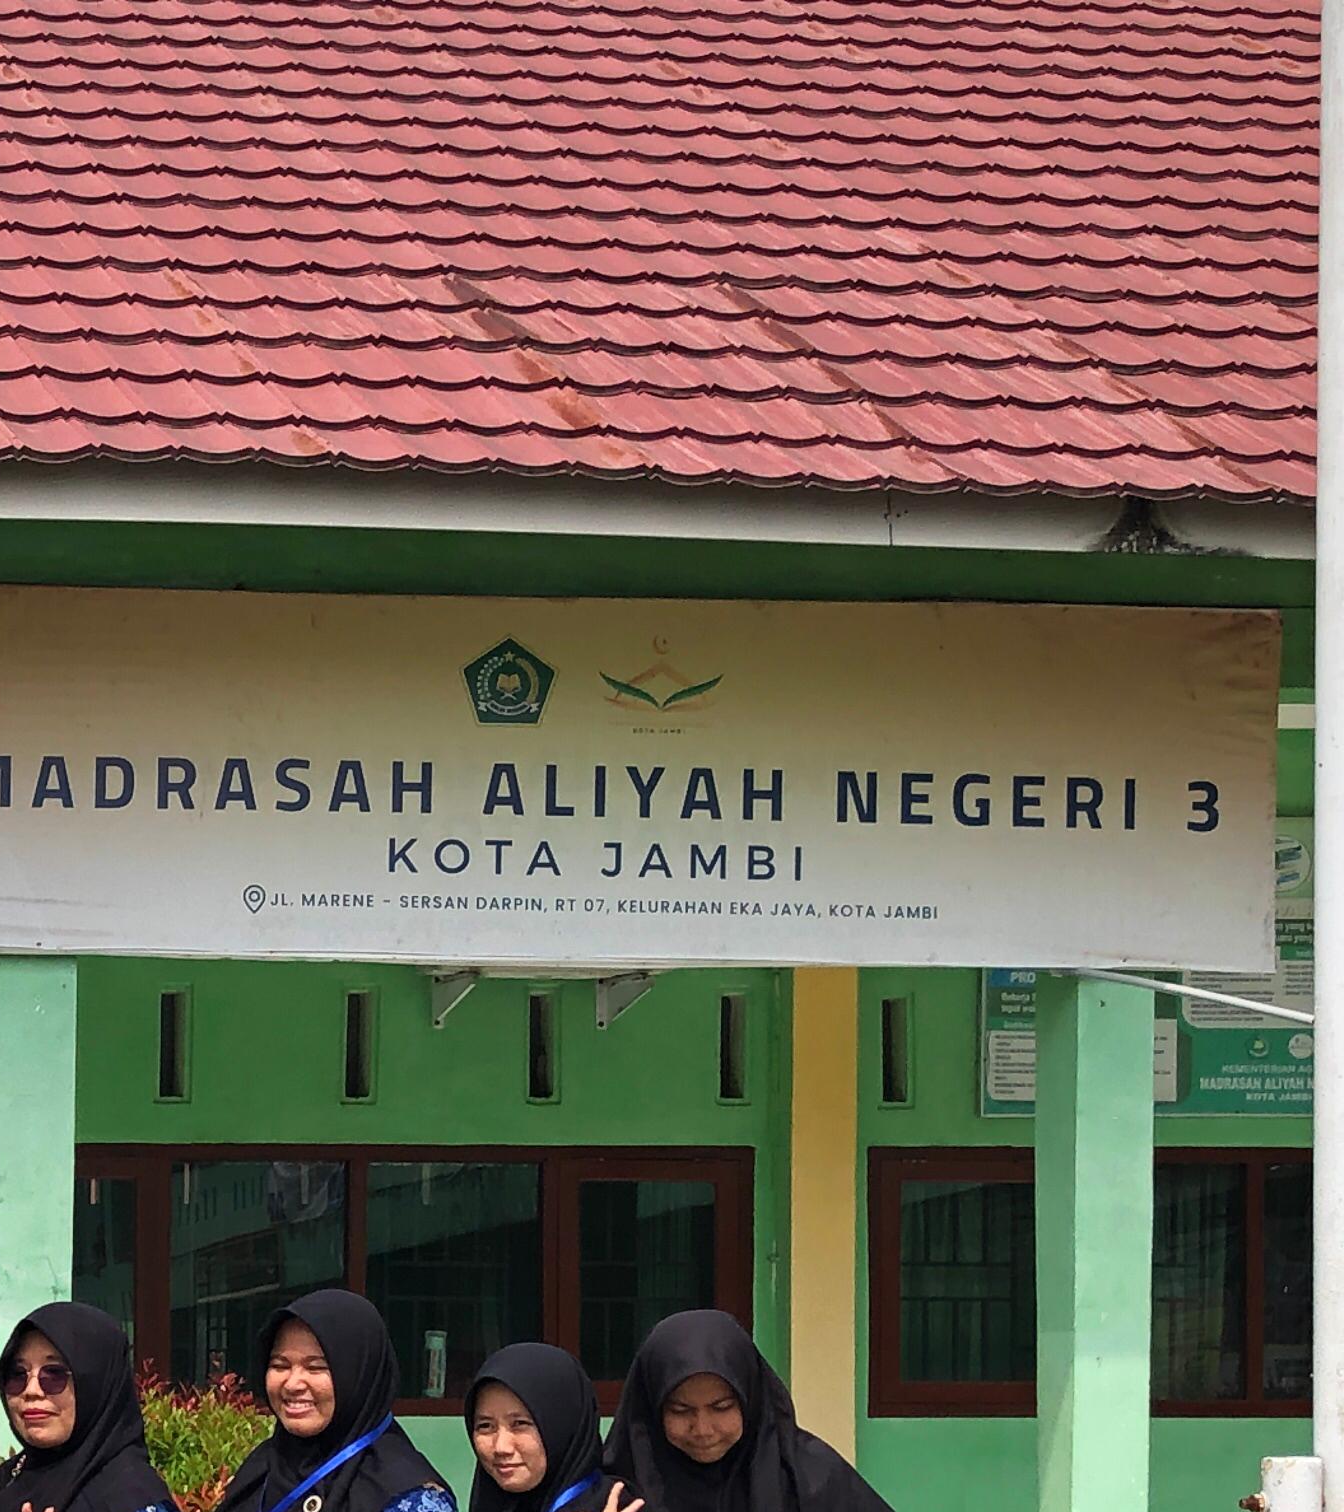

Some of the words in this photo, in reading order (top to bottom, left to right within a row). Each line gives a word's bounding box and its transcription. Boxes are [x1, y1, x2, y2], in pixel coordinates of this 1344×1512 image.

[482, 763, 783, 822] ALIYAH
[836, 770, 1136, 830] NEGERI
[1187, 781, 1220, 832] 3
[388, 837, 562, 877] KOTA
[600, 842, 802, 882] JAMBI
[271, 895, 294, 907] JL.
[302, 894, 374, 907] MARENE
[400, 895, 468, 909] SERSAN
[476, 897, 547, 912] DARPIN,
[555, 899, 576, 912] RT
[584, 899, 610, 914] 07,
[618, 900, 723, 914] KELURAHAN
[730, 902, 762, 915] EKA
[770, 903, 822, 918] JAYA,
[829, 905, 876, 917] KOTA
[884, 906, 938, 919] JAMBI
